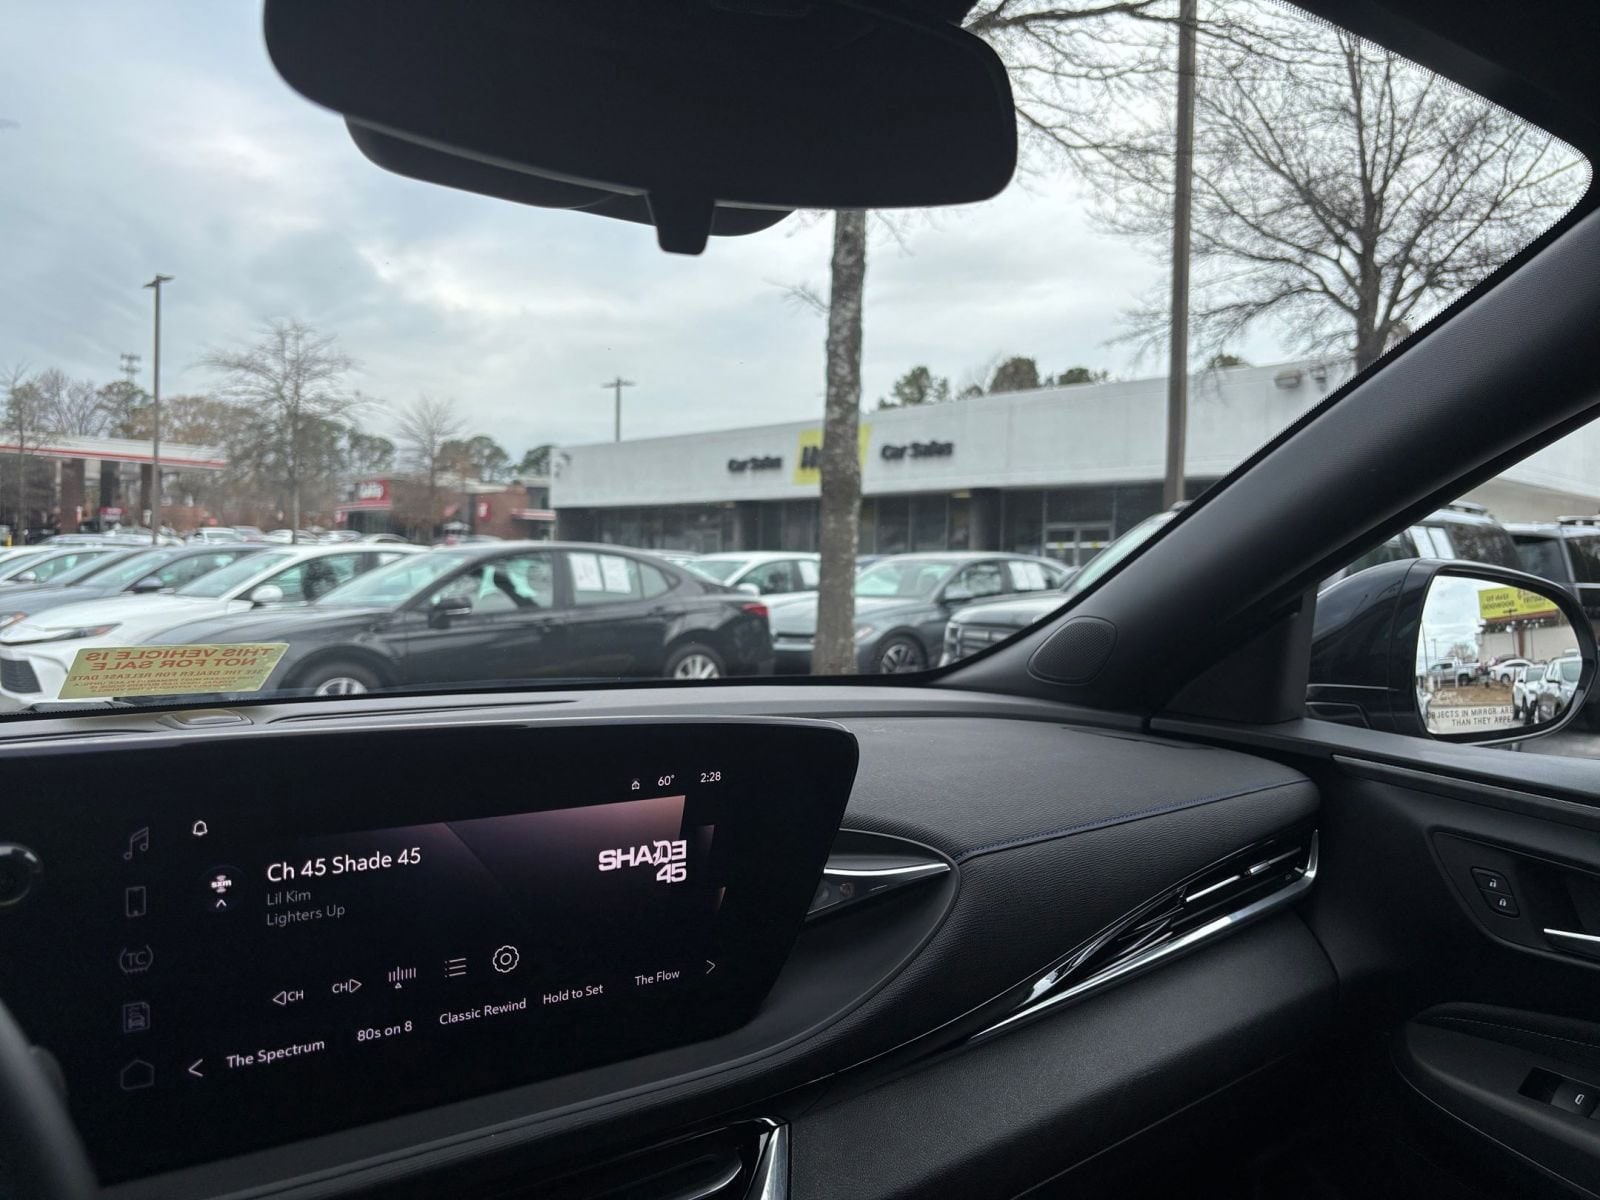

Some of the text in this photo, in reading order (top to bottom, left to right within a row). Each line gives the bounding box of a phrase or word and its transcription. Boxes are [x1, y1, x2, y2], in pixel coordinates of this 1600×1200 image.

[881, 445, 906, 460] Car
[1428, 707, 1459, 720] OBJECTS
[1461, 709, 1469, 717] IN
[1471, 706, 1496, 717] MIRROR
[1452, 718, 1472, 727] THAN
[1474, 716, 1492, 726] THEY
[700, 771, 721, 783] 2:28
[598, 839, 687, 872] SHADE
[267, 847, 422, 882] Ch 45 Shade 45
[656, 861, 687, 884] 45
[267, 890, 311, 906] Lil Kim
[267, 904, 345, 927] Lighters Up
[126, 951, 147, 967] TC
[634, 970, 680, 986] The Flow
[287, 990, 304, 1002] CH
[332, 983, 348, 994] CH
[543, 984, 604, 1005] Hold to Set
[439, 998, 527, 1025] Classic Rewind
[357, 1020, 413, 1042] 80s on 8
[226, 1040, 325, 1069] The Spectrum
